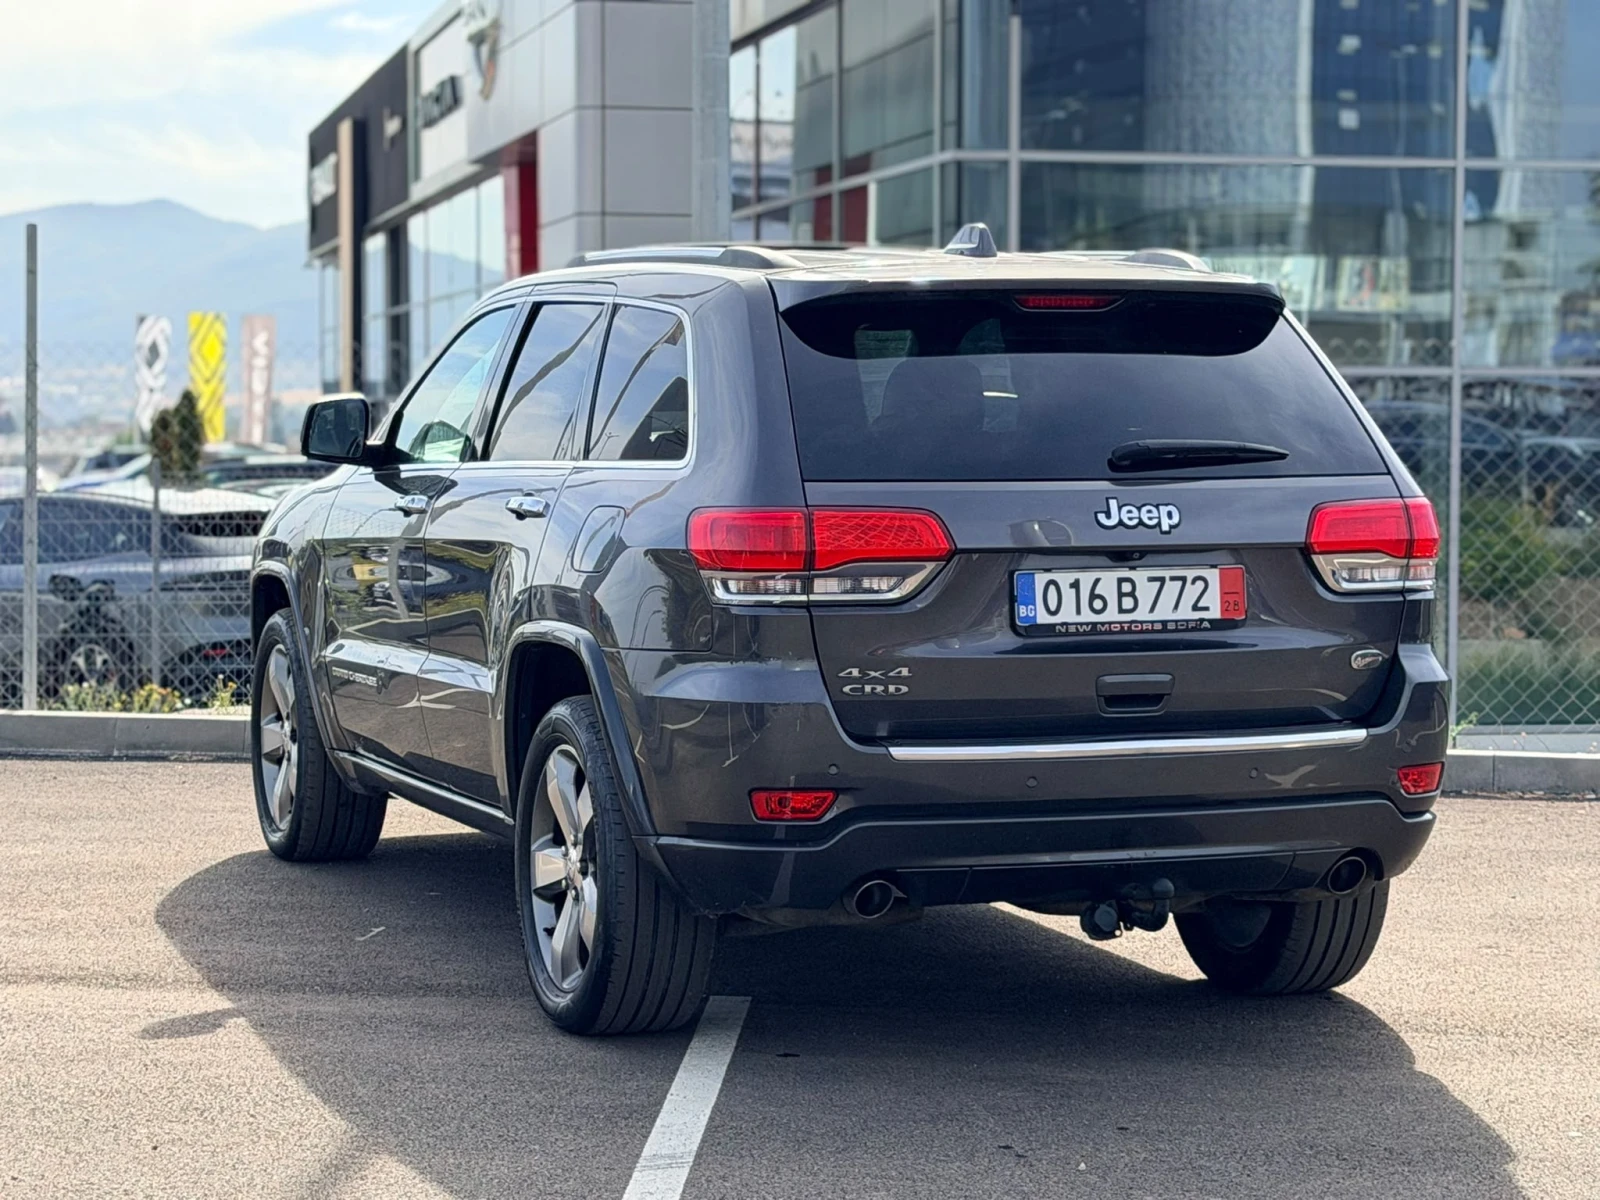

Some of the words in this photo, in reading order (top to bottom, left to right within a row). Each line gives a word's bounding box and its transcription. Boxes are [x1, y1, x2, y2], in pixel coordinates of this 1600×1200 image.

[1096, 498, 1181, 533] Jeep
[1018, 605, 1036, 617] BG
[1055, 623, 1093, 633] NEW
[1096, 622, 1163, 632] MOTORS
[1166, 620, 1211, 630] SOFIA
[837, 667, 913, 680] 4x4
[842, 684, 910, 696] CRD
